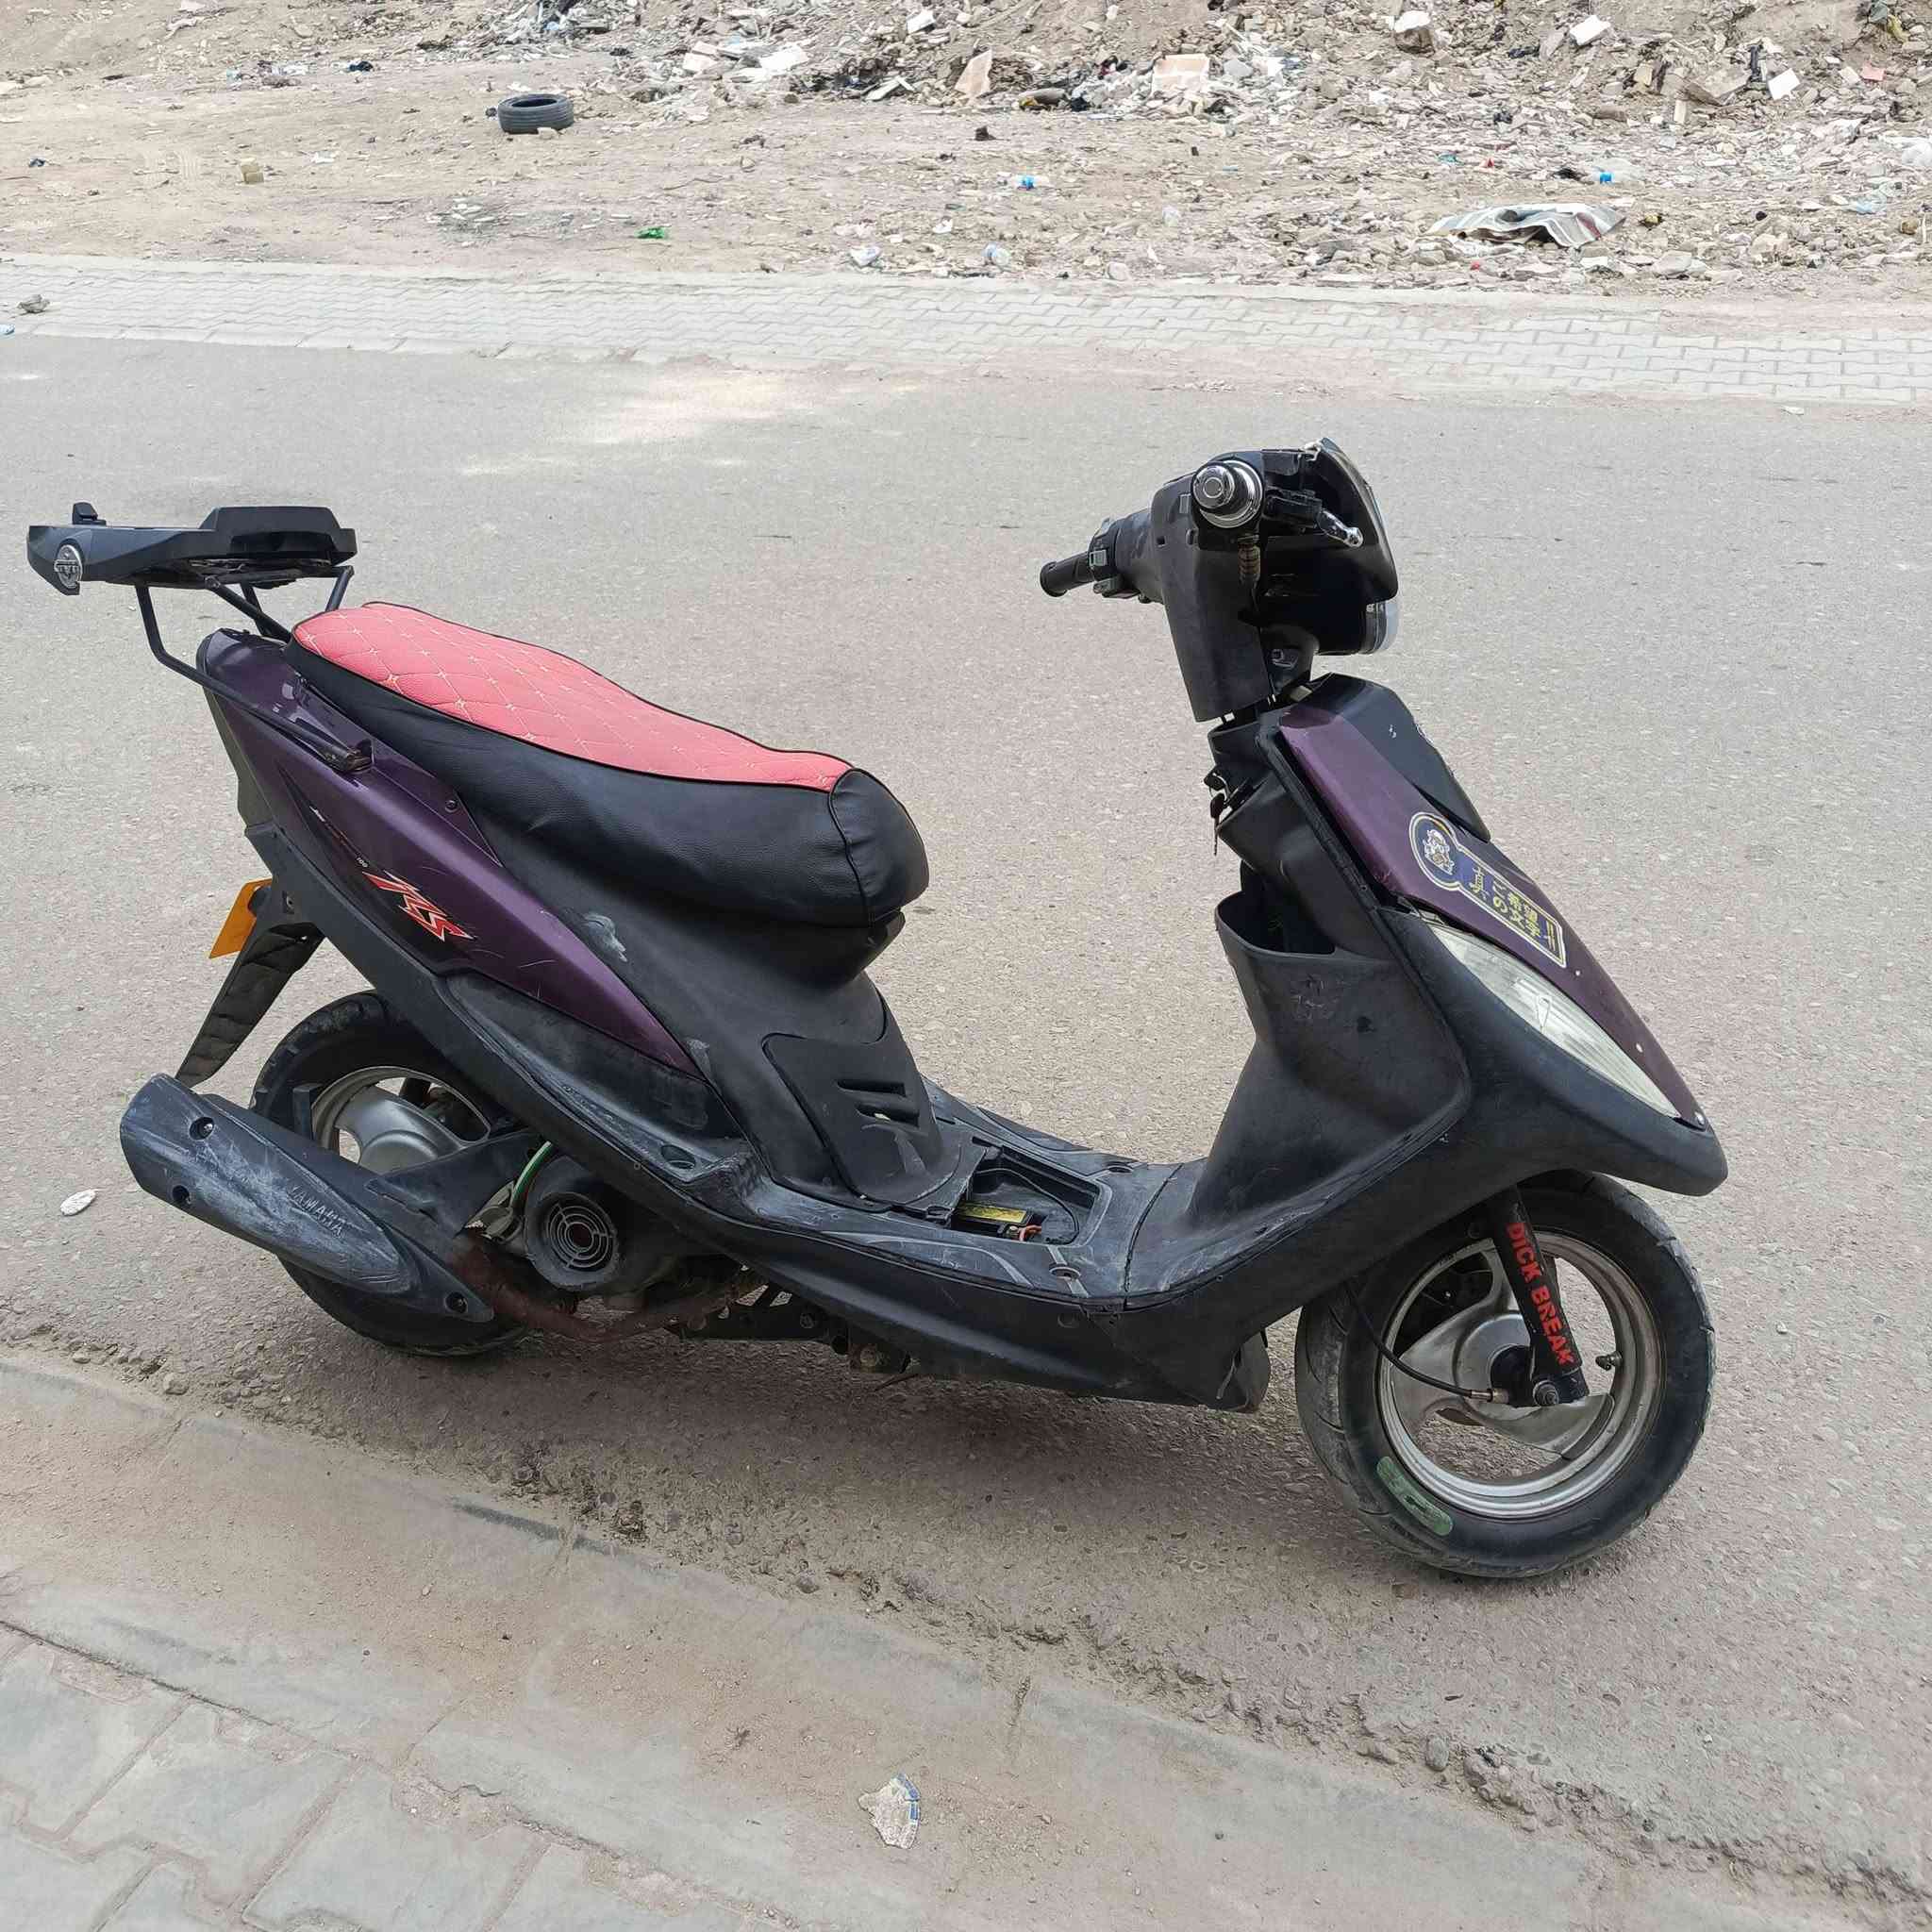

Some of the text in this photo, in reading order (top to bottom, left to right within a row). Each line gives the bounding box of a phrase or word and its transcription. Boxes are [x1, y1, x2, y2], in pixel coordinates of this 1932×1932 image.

[290, 1184, 344, 1239] YAMAHA
[1507, 1222, 1575, 1366] DICK BREAK
